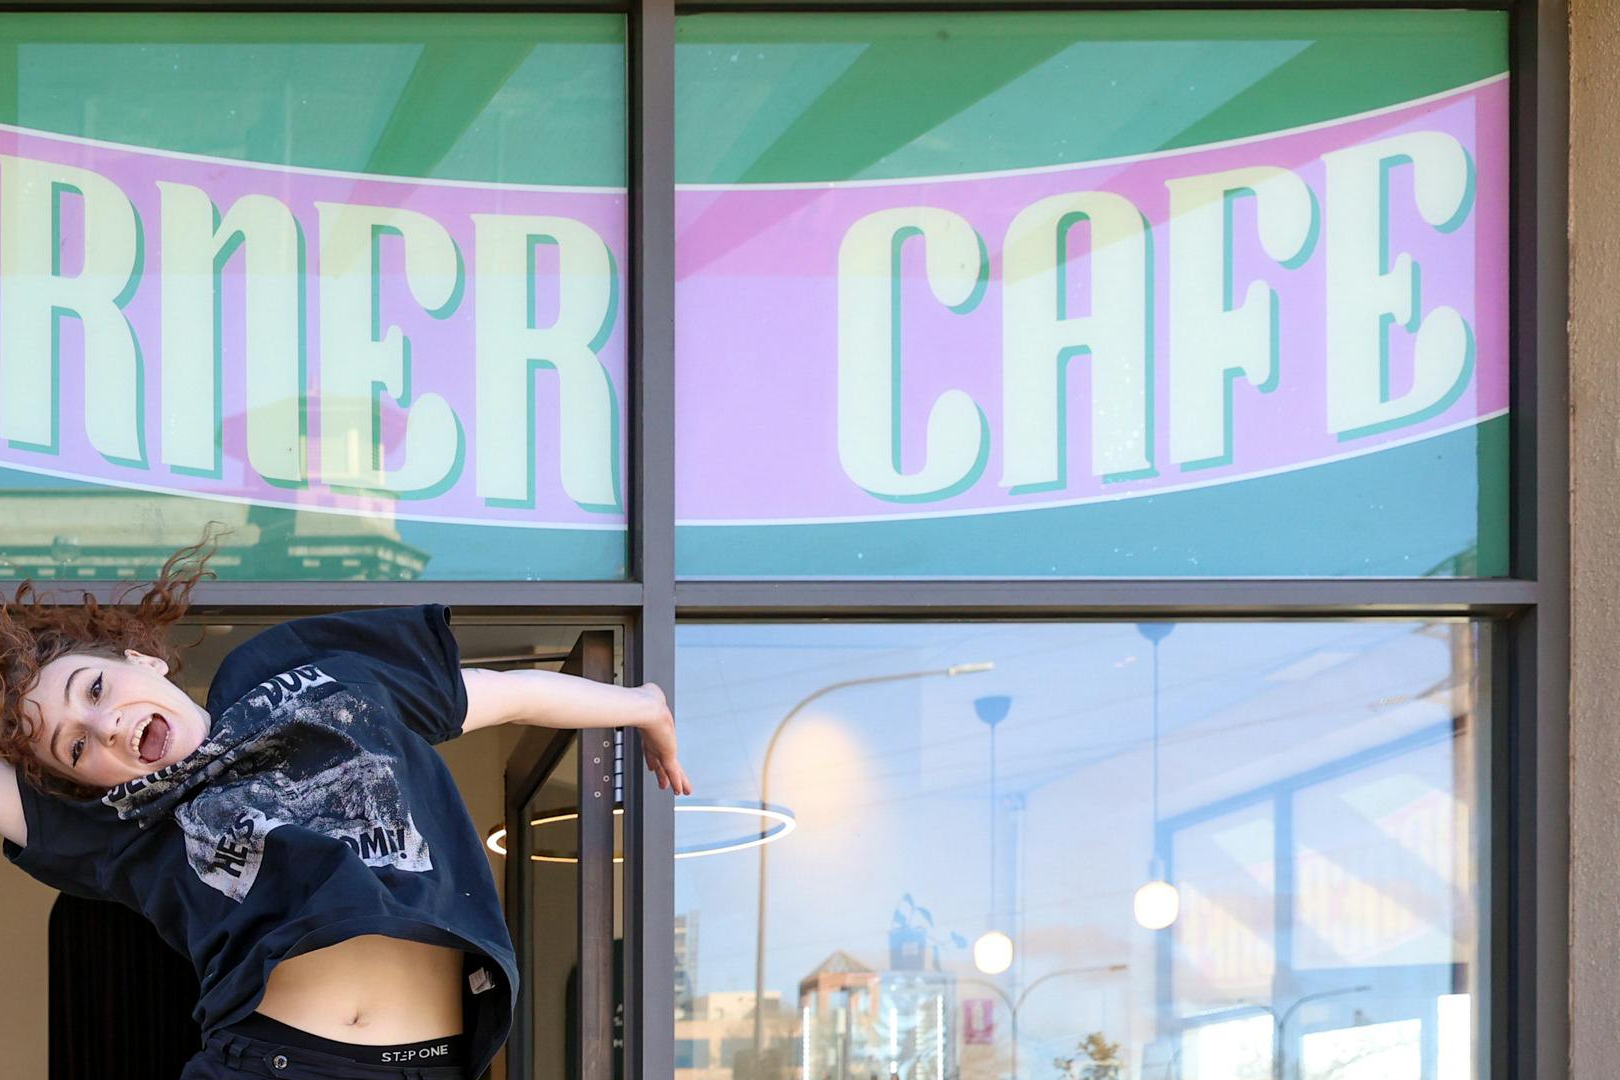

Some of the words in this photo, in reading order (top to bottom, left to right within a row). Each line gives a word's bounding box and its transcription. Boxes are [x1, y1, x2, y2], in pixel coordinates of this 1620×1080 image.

[838, 130, 1476, 503] CAFE
[381, 1050, 416, 1062] STEP
[419, 1044, 449, 1058] ONE
